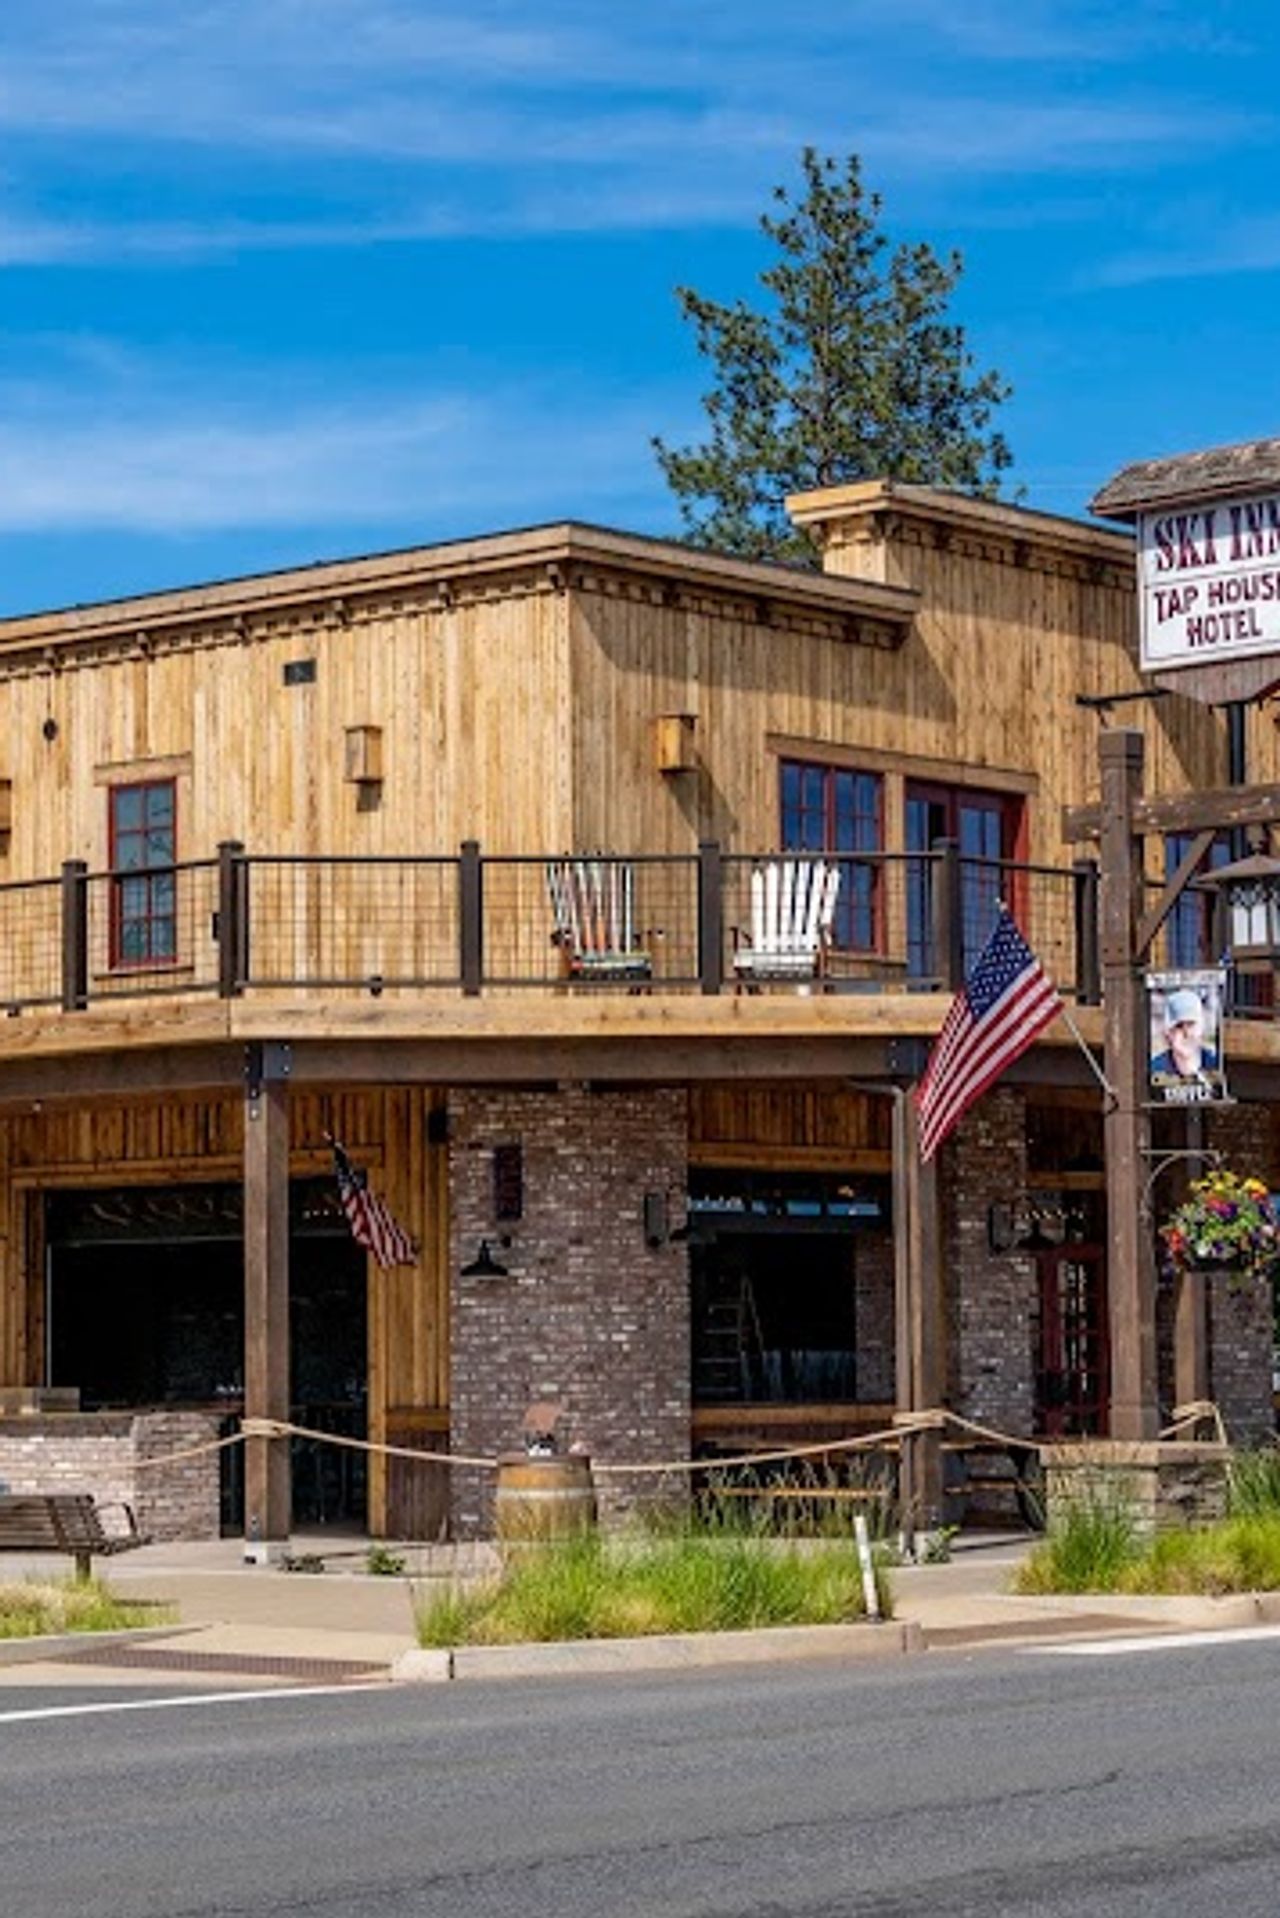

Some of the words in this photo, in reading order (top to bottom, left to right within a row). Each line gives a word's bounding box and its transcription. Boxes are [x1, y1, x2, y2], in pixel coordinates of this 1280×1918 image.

[1154, 511, 1217, 571] SKI
[1154, 585, 1199, 624] TAP
[1187, 607, 1262, 647] HOTEL
